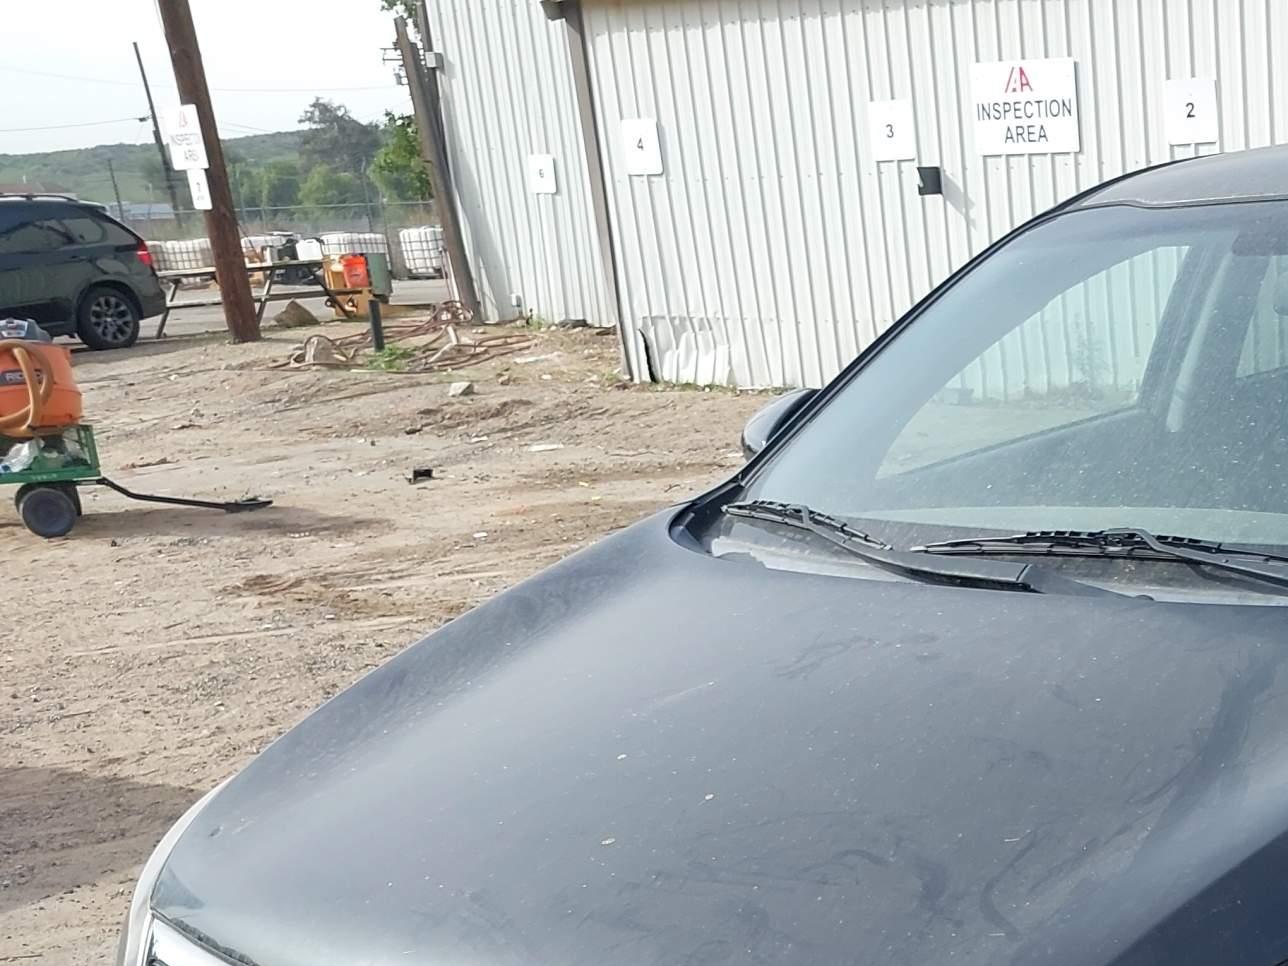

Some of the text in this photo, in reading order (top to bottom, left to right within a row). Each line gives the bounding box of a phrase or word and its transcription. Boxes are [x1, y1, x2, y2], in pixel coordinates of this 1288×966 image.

[977, 98, 1072, 121] INSPECTION
[1186, 102, 1196, 119] 2
[886, 123, 895, 138] 3
[1004, 124, 1049, 144] AREA
[636, 137, 645, 151] 4
